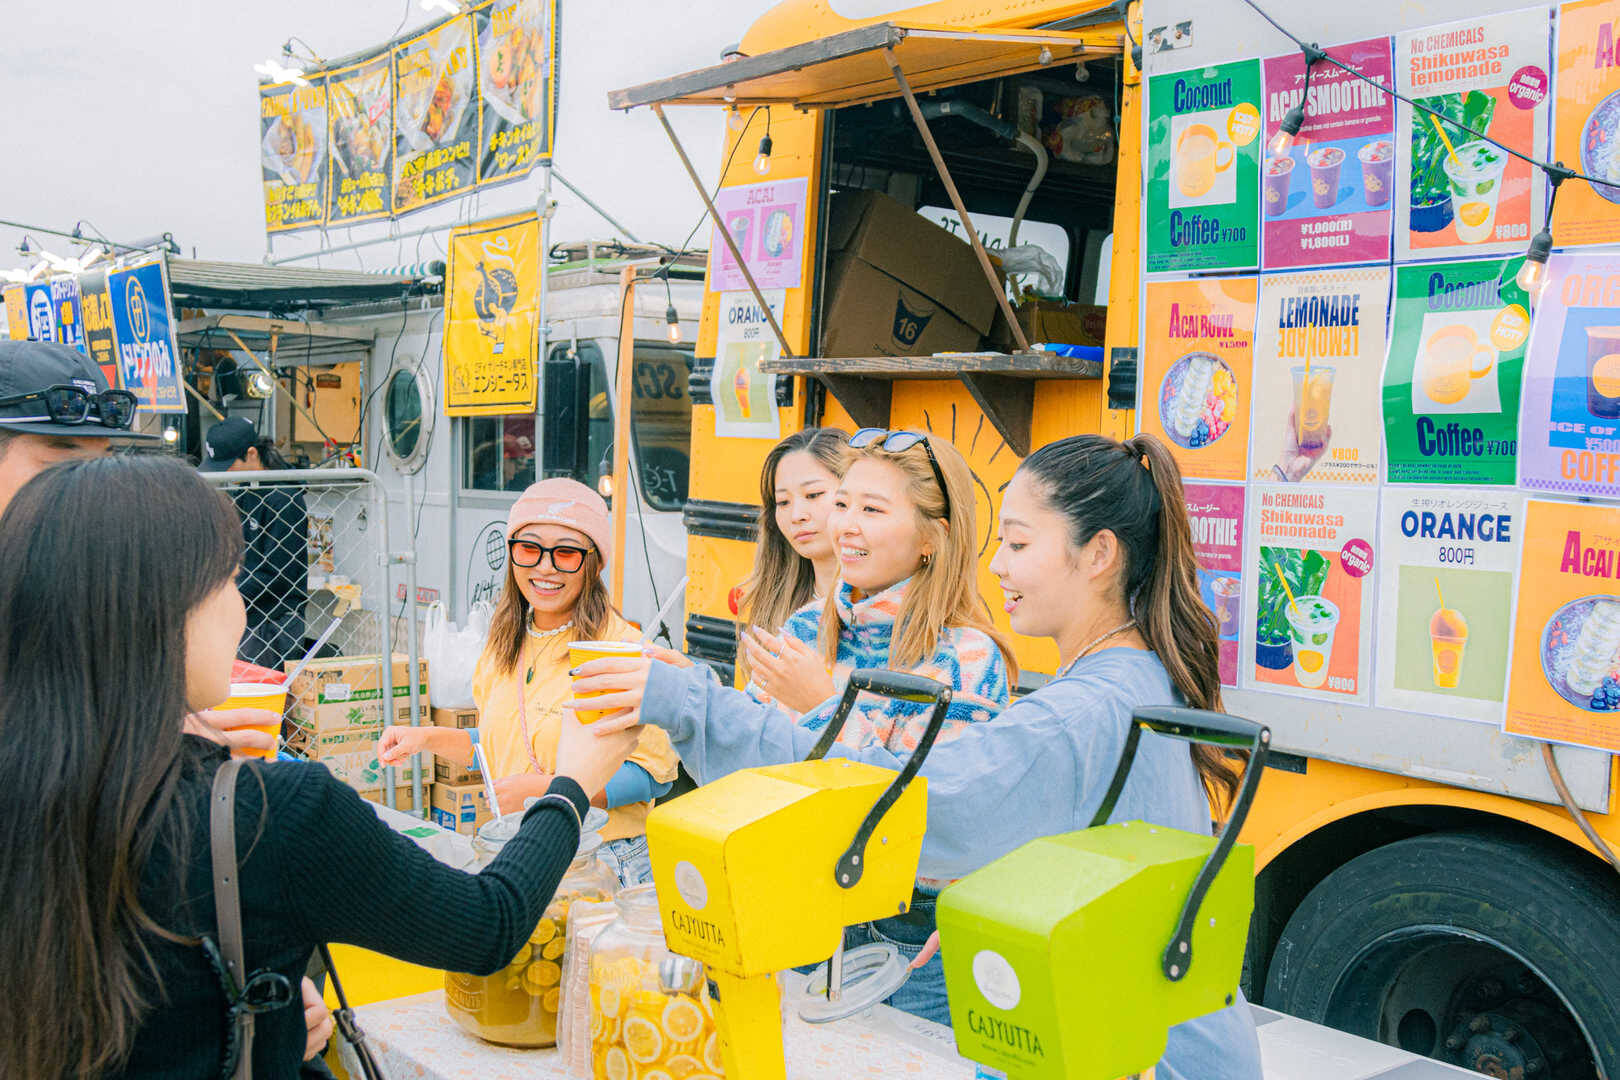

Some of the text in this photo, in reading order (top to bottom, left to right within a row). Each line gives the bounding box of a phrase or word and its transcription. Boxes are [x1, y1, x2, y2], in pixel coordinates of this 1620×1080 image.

[1426, 26, 1485, 51] CHEMICALS
[1410, 60, 1502, 87] lemonade
[1174, 78, 1232, 113] Coconut
[1308, 75, 1386, 116] SMOOTHIE
[1170, 210, 1246, 247] Coffee ¥700
[1279, 294, 1360, 328] LEMONADE
[900, 318, 918, 340] 16
[1416, 416, 1516, 456] Coffee ¥700
[1275, 493, 1324, 509] CHEMICALS
[1188, 516, 1238, 546] OOTHIE
[1260, 522, 1336, 539] lemonade
[1401, 510, 1512, 542] ORANGE
[1438, 546, 1474, 564] 800円
[968, 1008, 1044, 1057] CAJYUTTA
